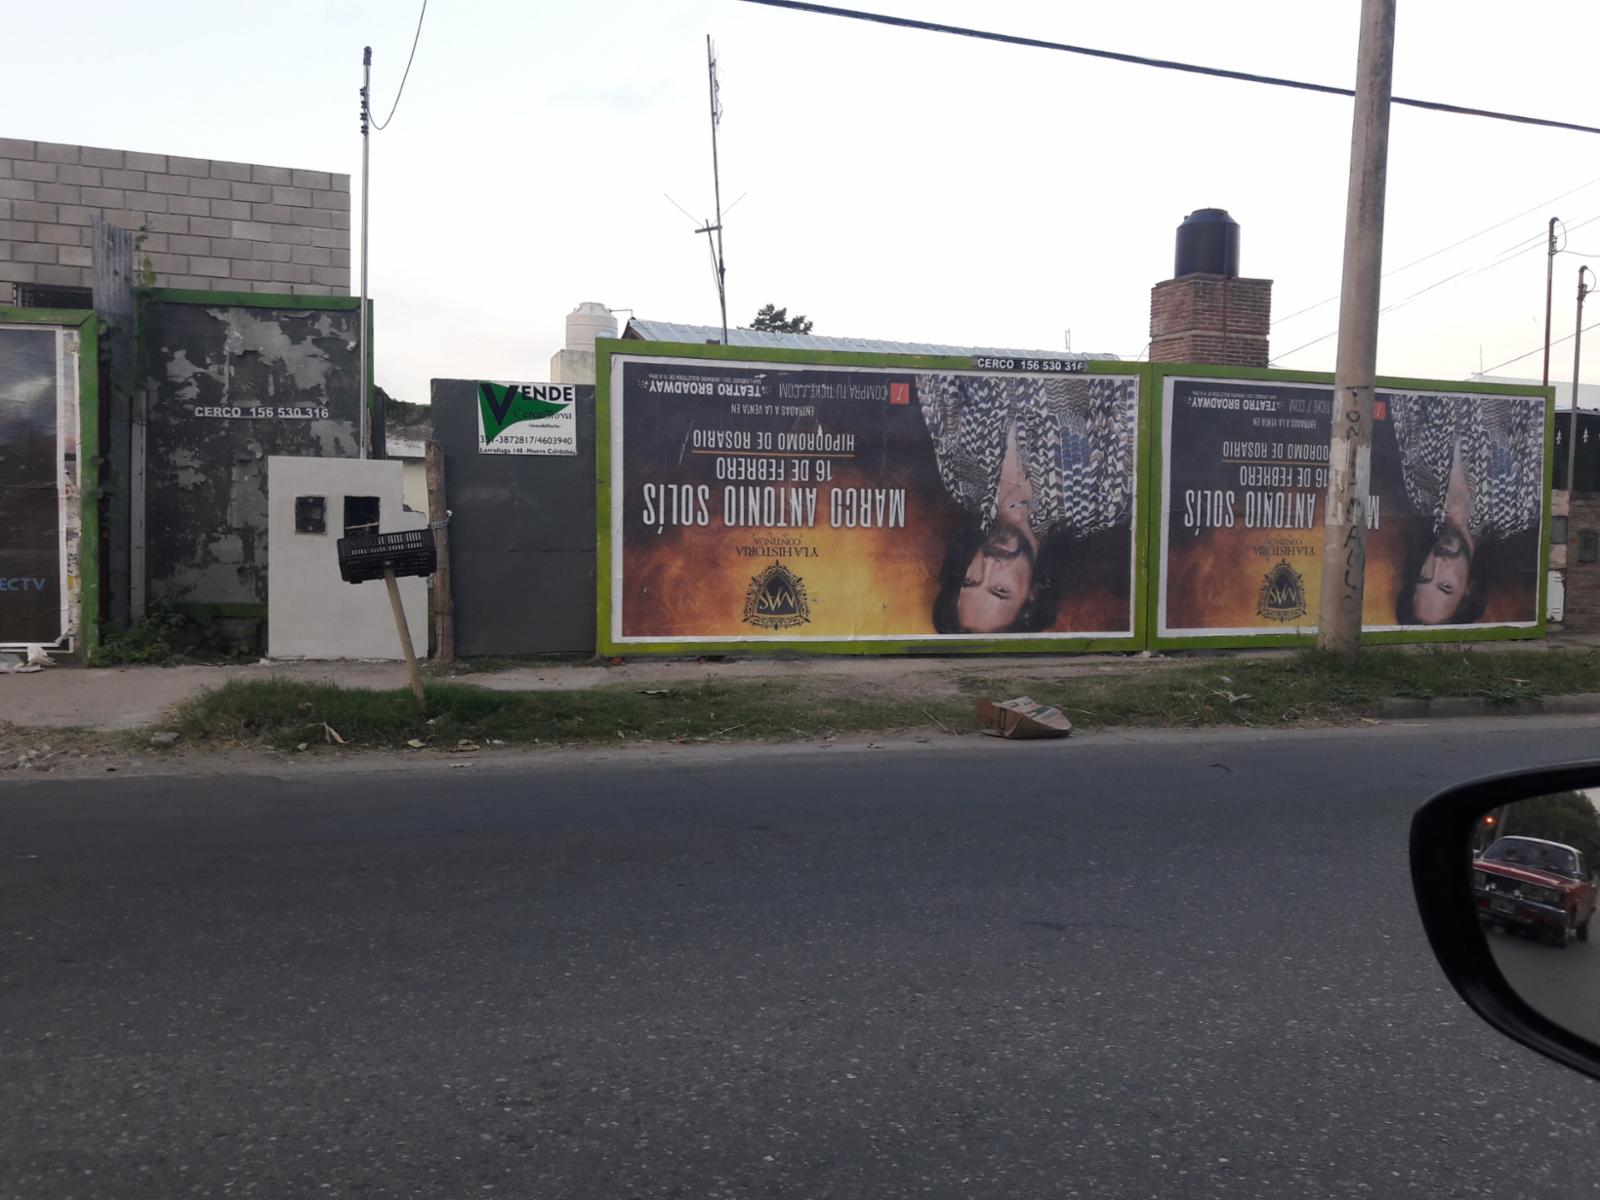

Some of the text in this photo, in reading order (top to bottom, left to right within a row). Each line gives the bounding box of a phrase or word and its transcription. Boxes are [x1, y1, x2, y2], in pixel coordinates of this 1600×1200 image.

[977, 358, 1014, 370] CERCO
[1020, 360, 1040, 370] 156
[1042, 361, 1061, 371] 530
[649, 380, 714, 395] BROADWAY
[717, 383, 761, 397] TEATRO
[480, 384, 573, 427] VENDE
[731, 403, 815, 416] ENTRADAS A LA VENTA EN
[1191, 396, 1277, 412] TEATRO BROADWAY
[194, 406, 329, 419] CERCO 156 530 316
[692, 429, 855, 451] HIPODROMO DE ROSARIO
[1222, 441, 1329, 460] ODROMO DE ROSARIO
[716, 457, 833, 482] 16 DE FEBRERO
[1239, 465, 1328, 488] 16 DE FEBRERO
[642, 482, 905, 534] MARCO ANTONIO SOLÍS
[1184, 489, 1235, 537] SOLÍS
[1245, 490, 1316, 529] ANTONIO
[735, 545, 818, 557] Y LA HISTORIA
[1296, 546, 1308, 556] LA
[1309, 546, 1315, 556] Y
[0, 577, 47, 591] ECTV
